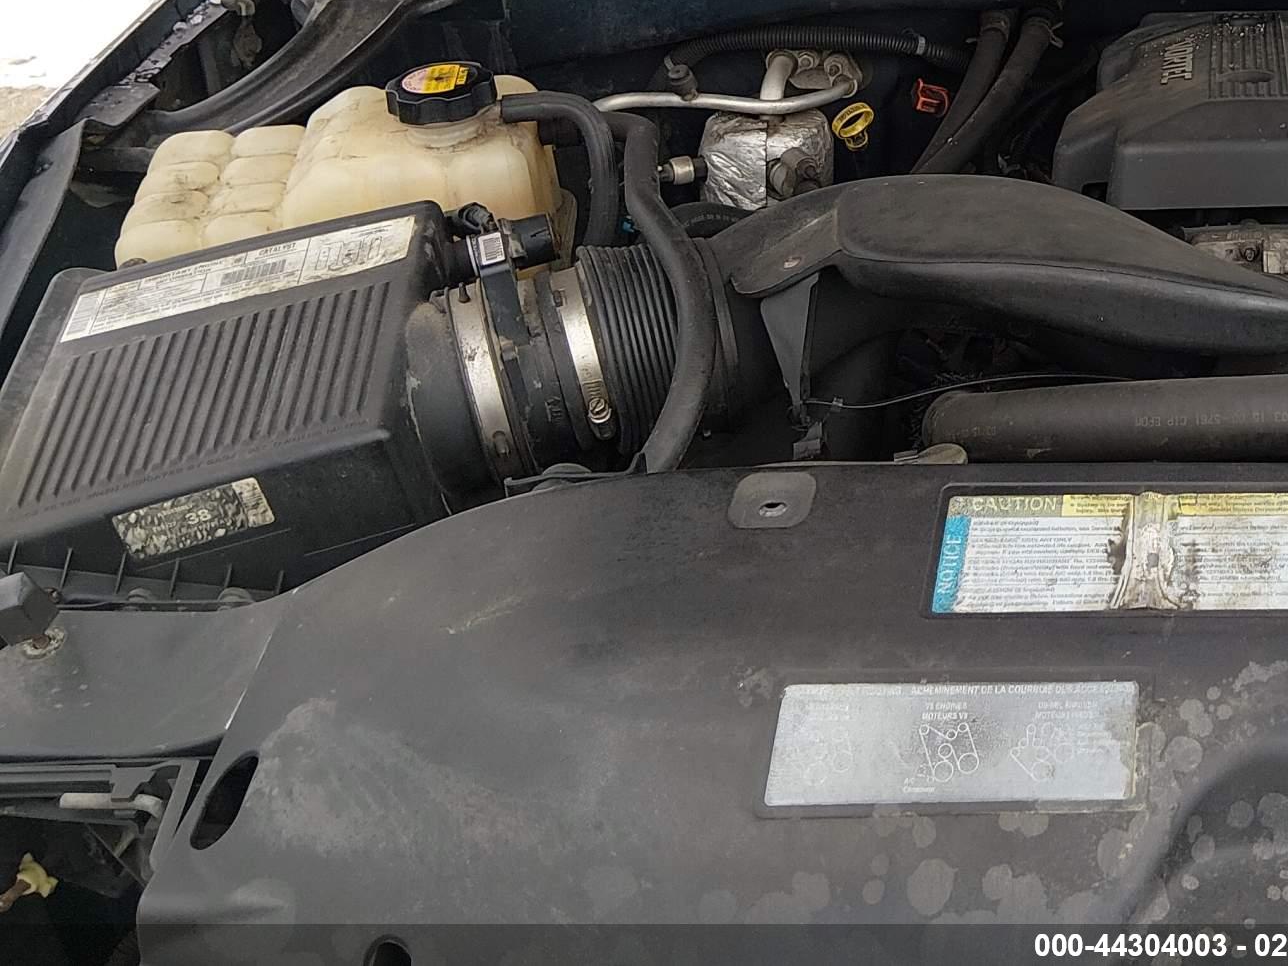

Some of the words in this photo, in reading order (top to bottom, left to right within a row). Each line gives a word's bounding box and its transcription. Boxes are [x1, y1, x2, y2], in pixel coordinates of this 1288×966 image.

[972, 497, 1057, 512] CAUTION
[185, 508, 212, 525] 38
[937, 535, 962, 593] NOTICE
[981, 685, 993, 694] DE
[994, 685, 1006, 694] LA
[921, 712, 958, 720] MOTEURS
